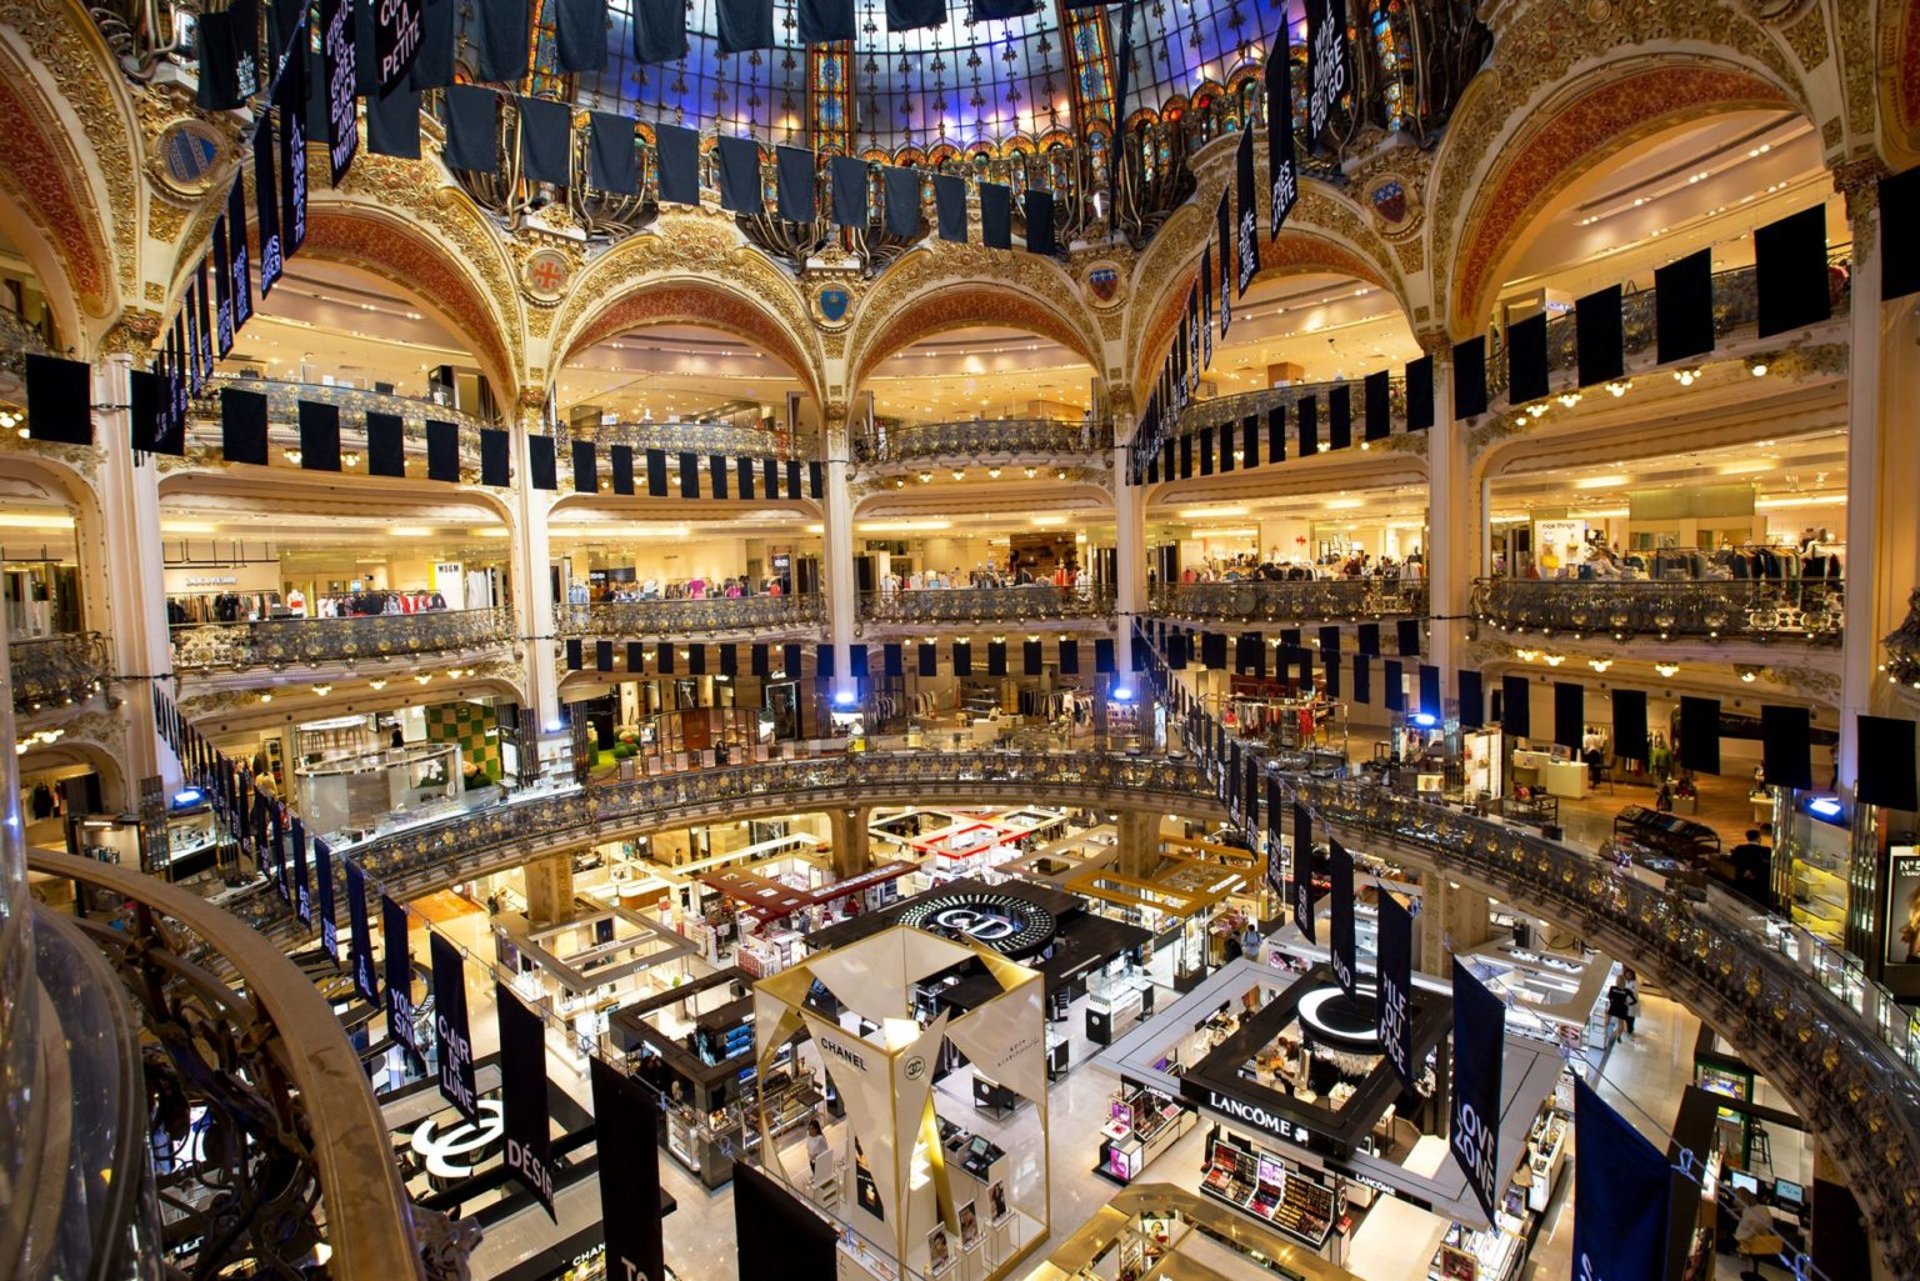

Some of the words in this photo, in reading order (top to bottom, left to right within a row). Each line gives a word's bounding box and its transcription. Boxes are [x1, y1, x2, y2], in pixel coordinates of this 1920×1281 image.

[396, 1, 410, 40] LA
[382, 10, 421, 83] PETITE
[332, 72, 357, 124] BLACK
[1328, 64, 1345, 104] GO
[338, 101, 354, 142] AND
[438, 1015, 471, 1065] CLAIR
[820, 1036, 868, 1072] CHANEL
[1380, 1018, 1406, 1076] FACE
[448, 1049, 463, 1082] DE
[442, 1066, 476, 1115] LUNE
[1210, 1091, 1292, 1138] LANCÔME
[1355, 1173, 1396, 1194] LANCÔME
[1454, 1117, 1496, 1208] ZONE
[572, 1242, 606, 1267] CHAN
